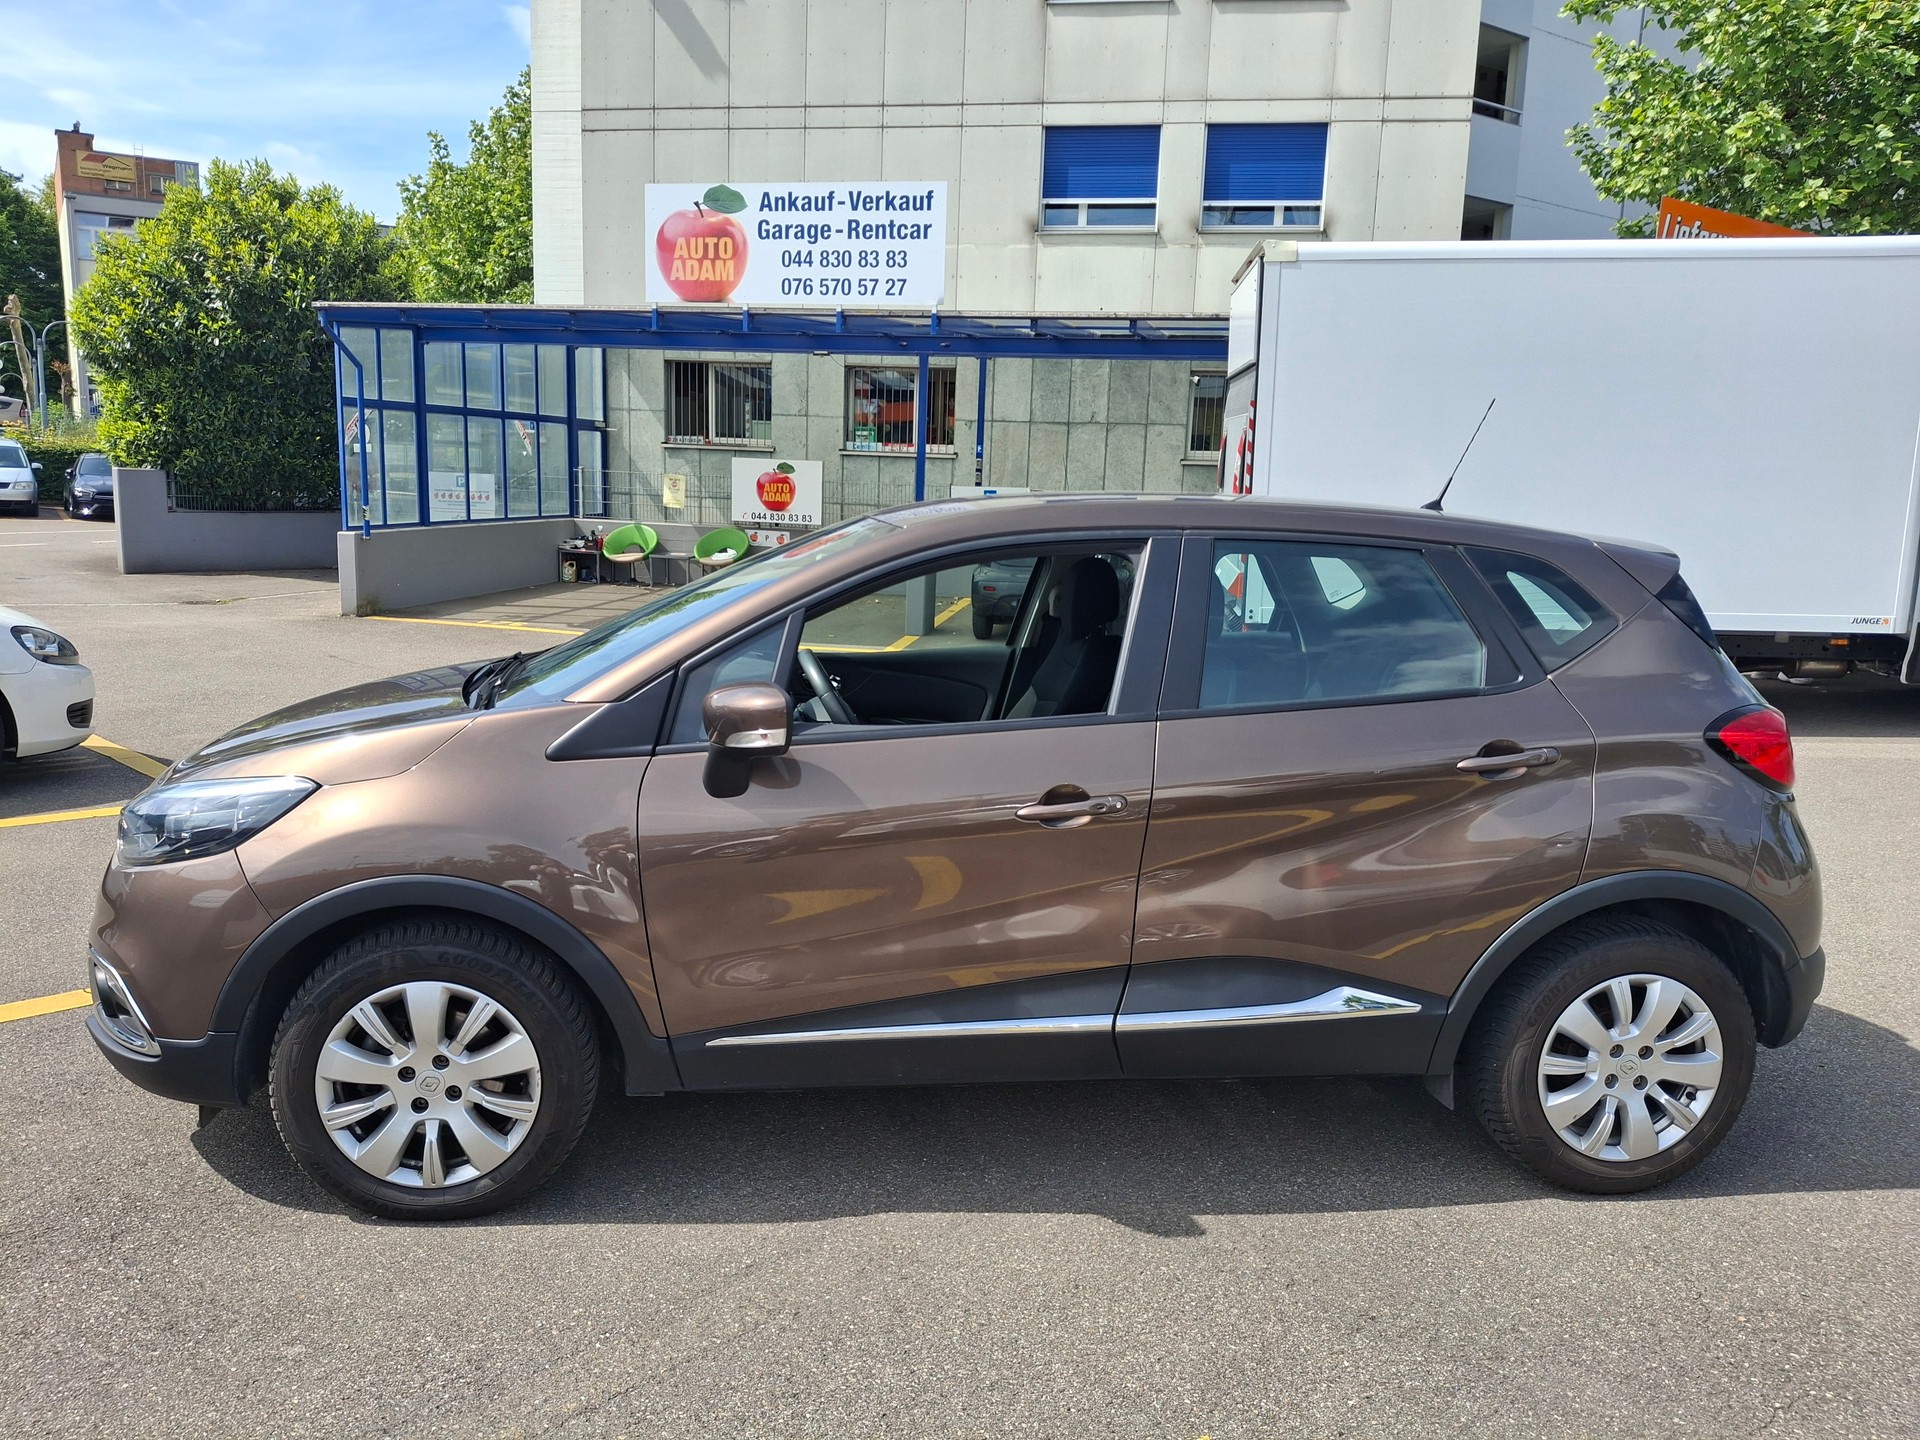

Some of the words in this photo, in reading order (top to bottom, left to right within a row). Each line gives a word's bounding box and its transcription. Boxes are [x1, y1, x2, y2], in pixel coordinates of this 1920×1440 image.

[673, 236, 734, 259] AUTO
[781, 250, 814, 268] 044
[819, 250, 852, 268] 830
[857, 250, 880, 268] 83
[885, 250, 908, 268] 83
[670, 259, 735, 281] ADAM
[781, 278, 814, 296] 076
[819, 278, 852, 296] 570
[857, 278, 880, 296] 57
[885, 278, 908, 296] 27
[764, 483, 790, 493] AUTO
[762, 492, 791, 503] ADAM
[751, 512, 767, 520] 044
[769, 513, 786, 521] 830
[788, 514, 799, 522] 83
[801, 514, 812, 523] 83
[1851, 617, 1882, 625] JUNGE
